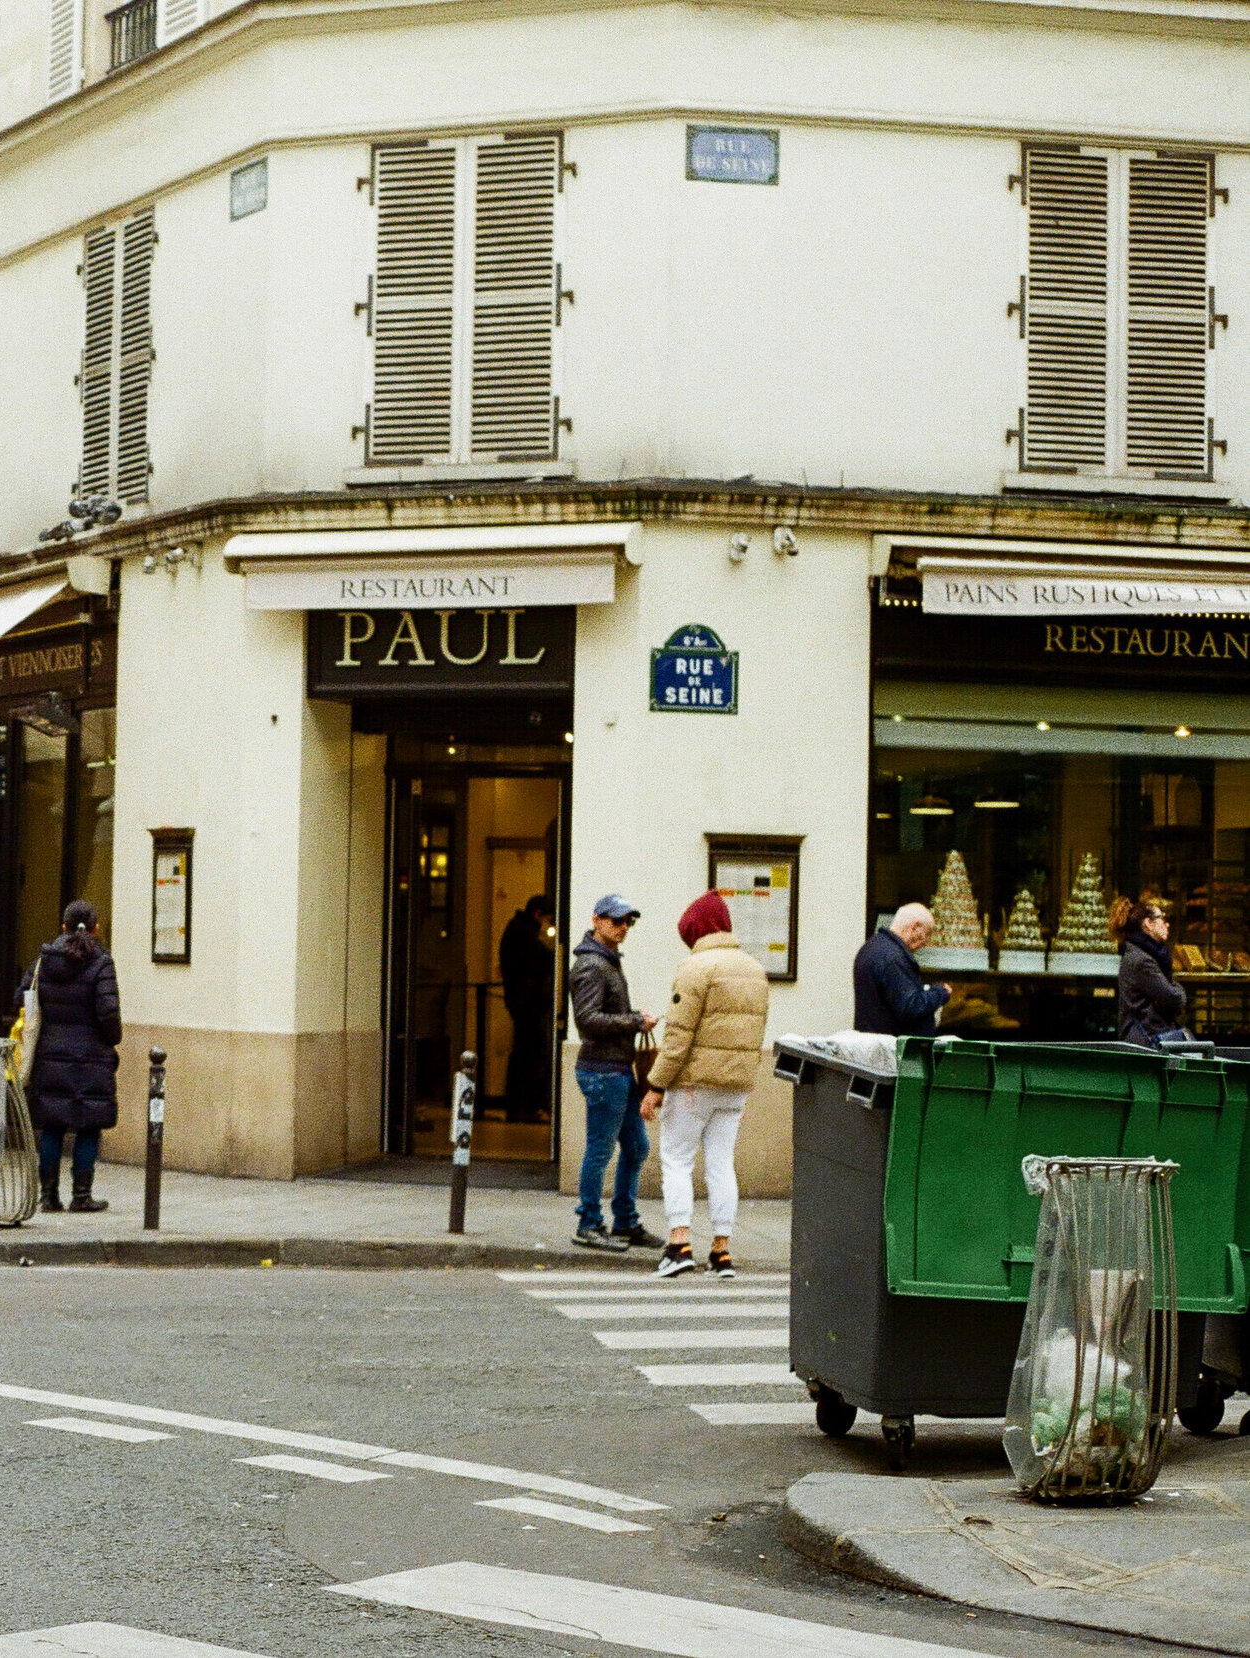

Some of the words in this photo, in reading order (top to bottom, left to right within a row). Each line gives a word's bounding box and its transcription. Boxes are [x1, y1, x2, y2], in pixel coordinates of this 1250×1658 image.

[339, 575, 516, 600] RESTAURANT
[944, 581, 1019, 604] PAINS
[334, 608, 547, 667] PAUL
[675, 657, 714, 676] RUE
[664, 686, 724, 705] SEINE
